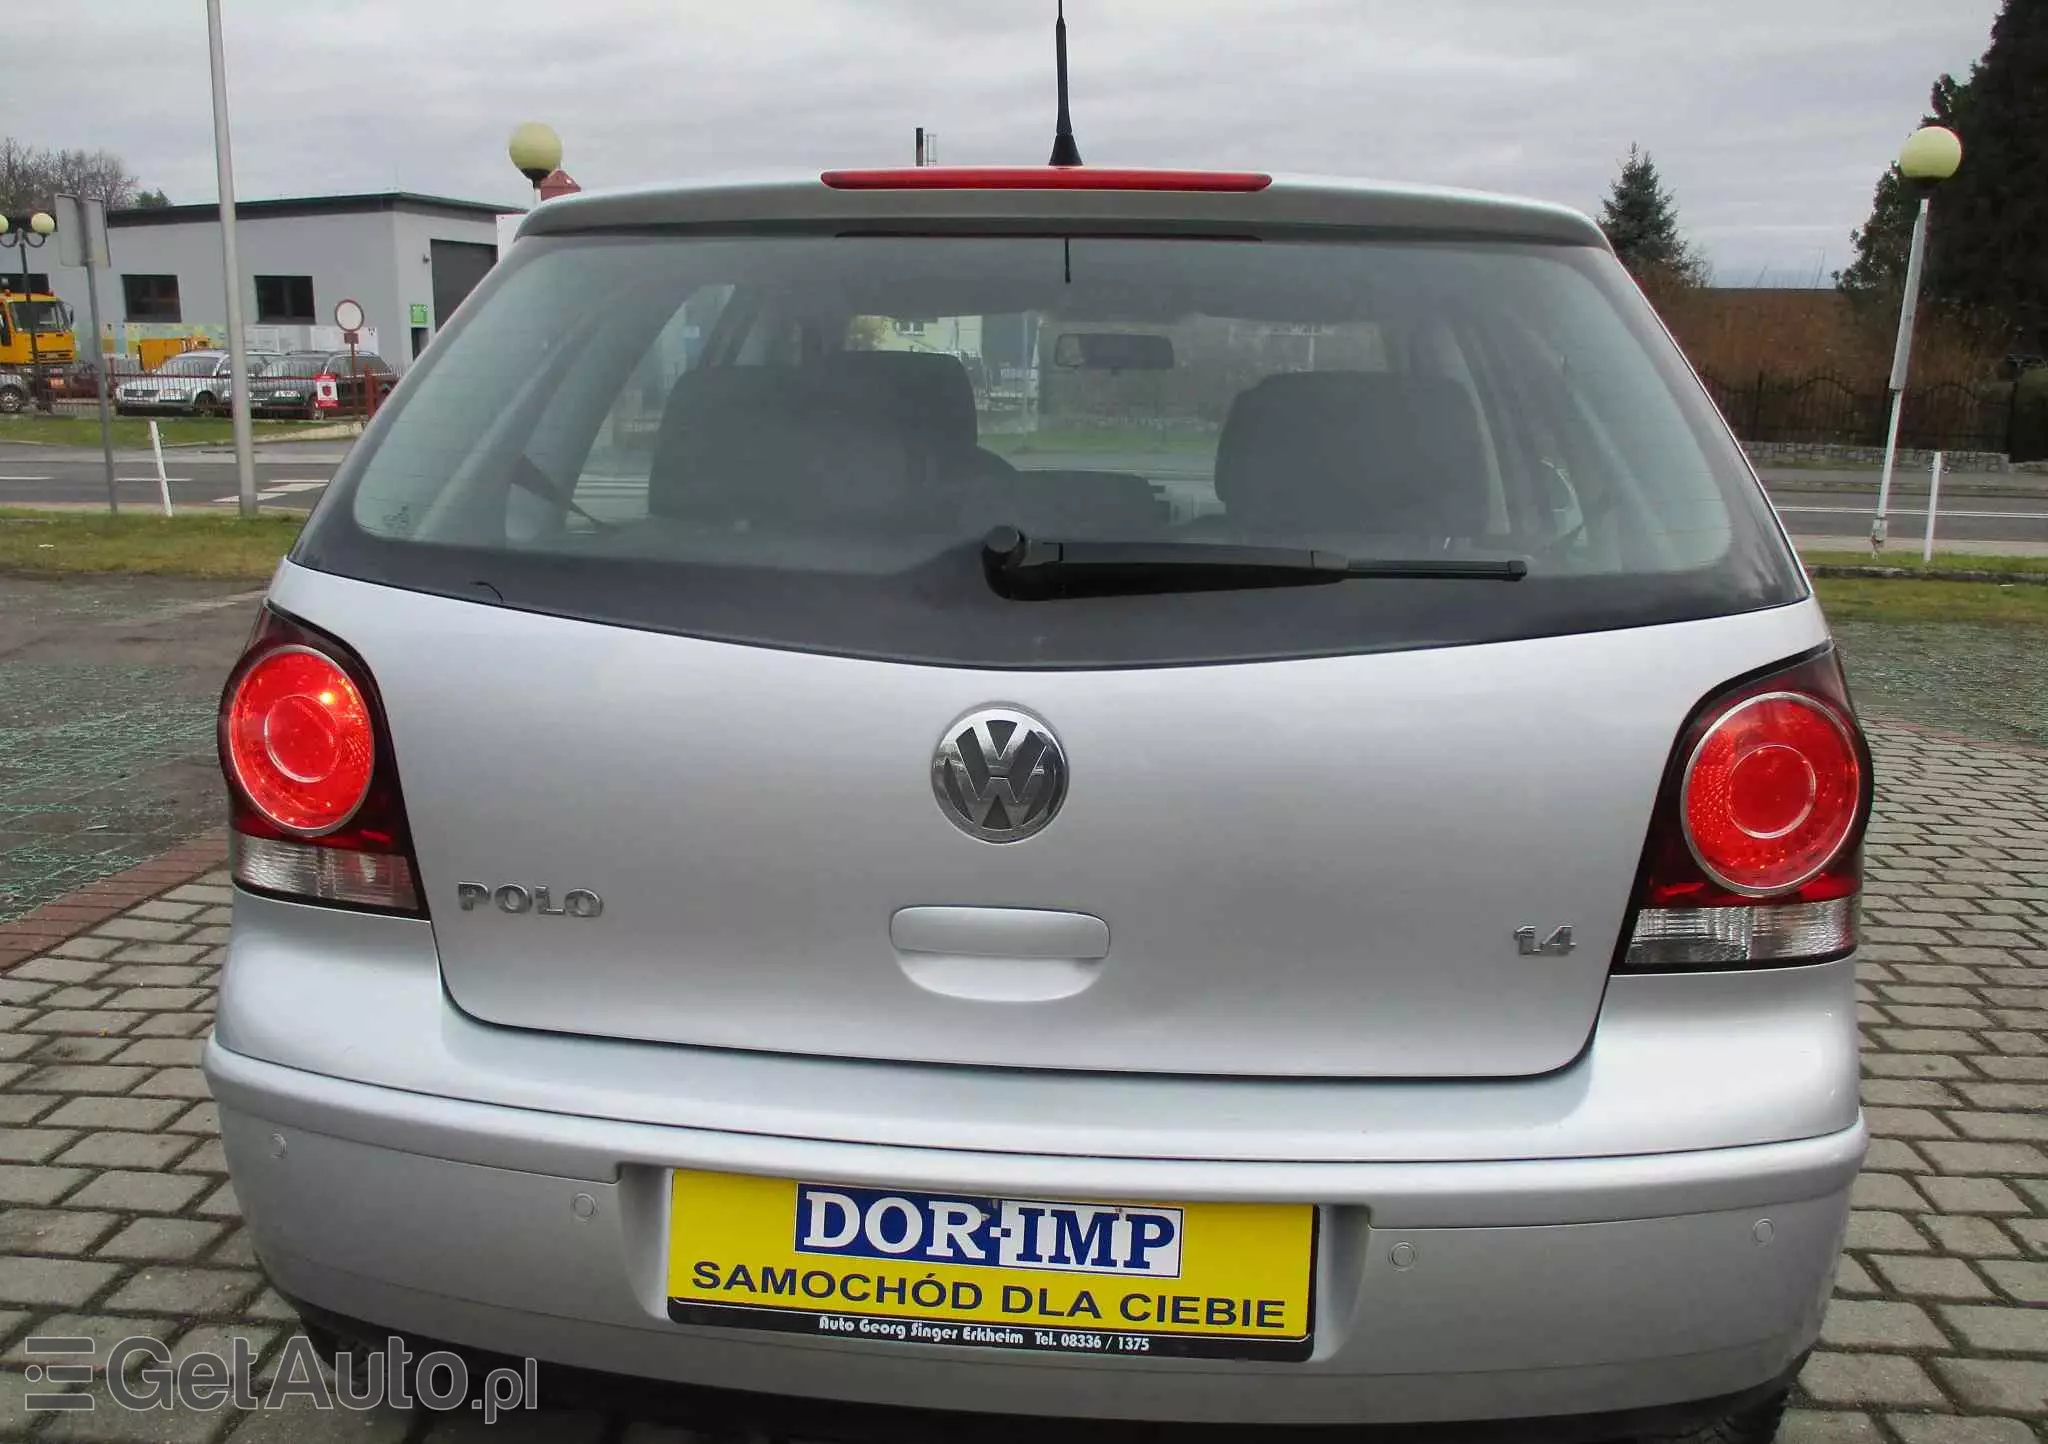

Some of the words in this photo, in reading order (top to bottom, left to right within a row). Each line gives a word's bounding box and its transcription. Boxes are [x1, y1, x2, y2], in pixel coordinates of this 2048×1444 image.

[457, 880, 604, 918] POLO
[803, 1190, 1175, 1270] DOR-IMP
[691, 1260, 983, 1310] SAMOCHÓD
[1001, 1284, 1102, 1319] DLA
[1119, 1293, 1286, 1328] CIEBIE
[819, 1315, 855, 1333] Auto
[859, 1317, 906, 1340] Georg
[911, 1322, 959, 1344] Singer
[962, 1325, 1024, 1345] Erkheim
[1035, 1331, 1057, 1346] Tel.
[1061, 1333, 1102, 1349] 08336
[1105, 1334, 1114, 1350] /
[1118, 1336, 1150, 1351] 1375
